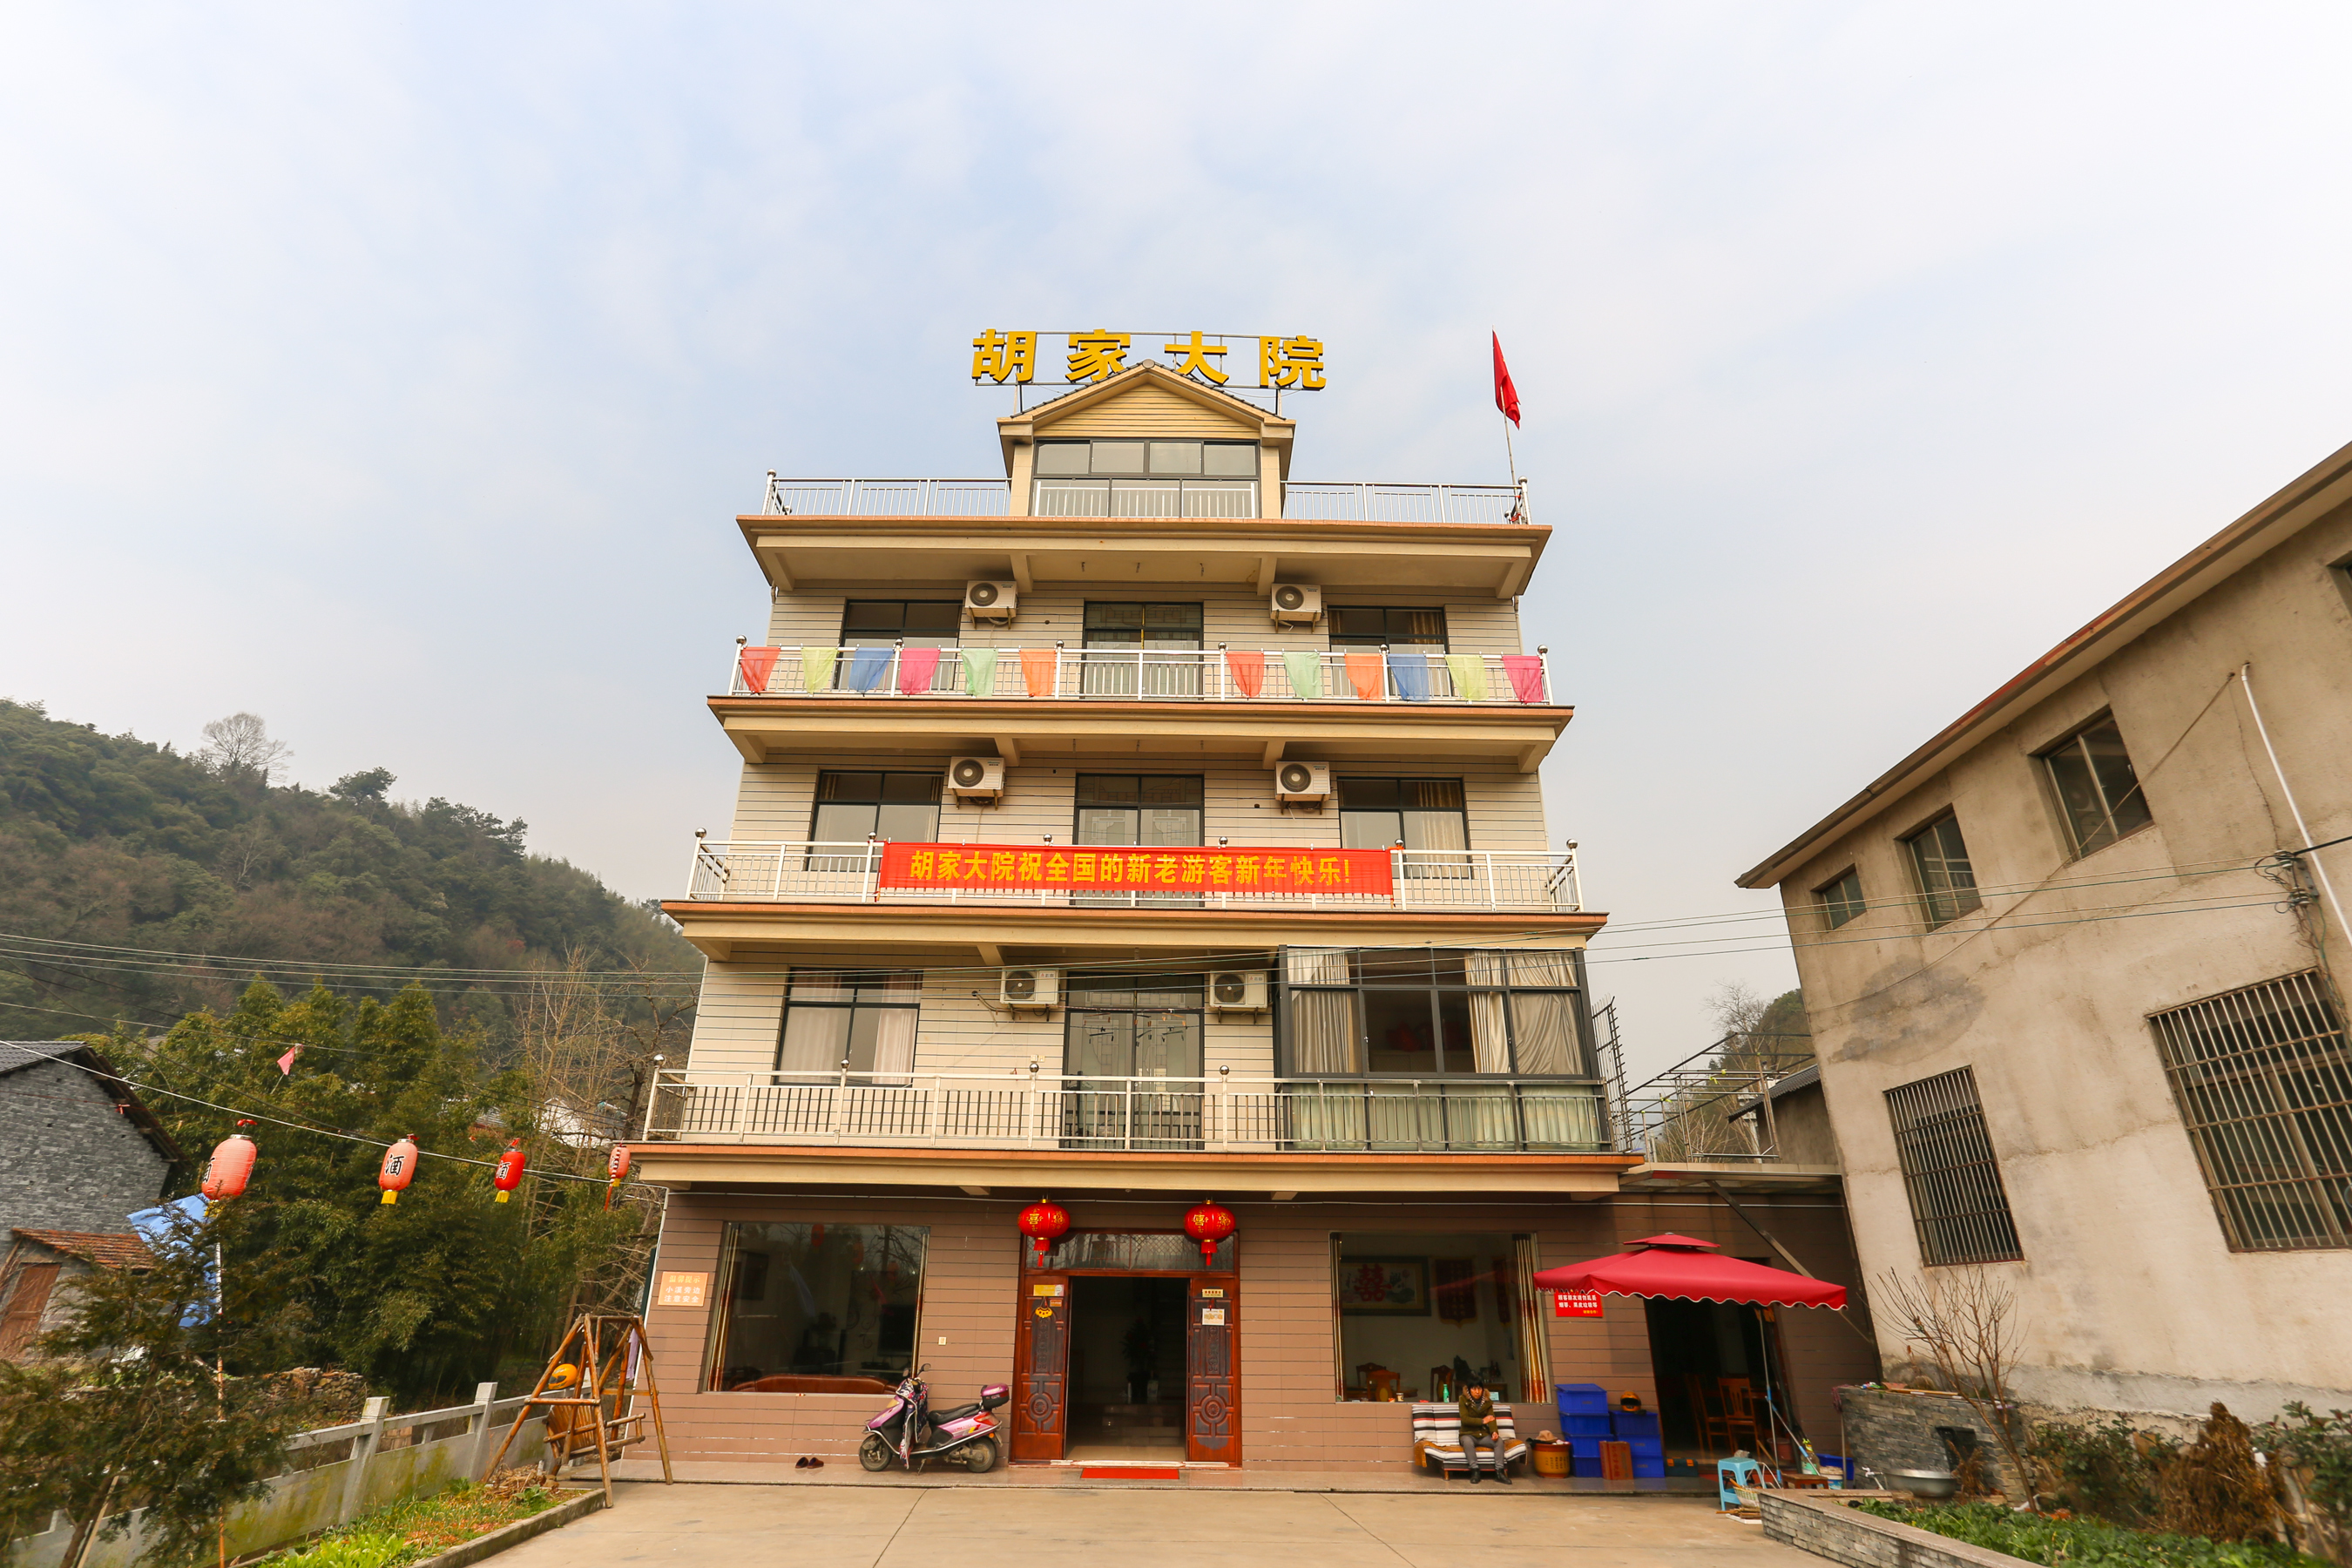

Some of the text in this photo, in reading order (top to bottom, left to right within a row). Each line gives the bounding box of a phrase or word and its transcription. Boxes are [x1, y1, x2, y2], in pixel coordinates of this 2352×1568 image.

[971, 328, 1327, 391] 胡家大院
[909, 849, 1350, 886] 胡家大院祝全国的新老游客新年快乐!
[385, 1152, 405, 1177] 酒
[497, 1160, 511, 1179] 酒
